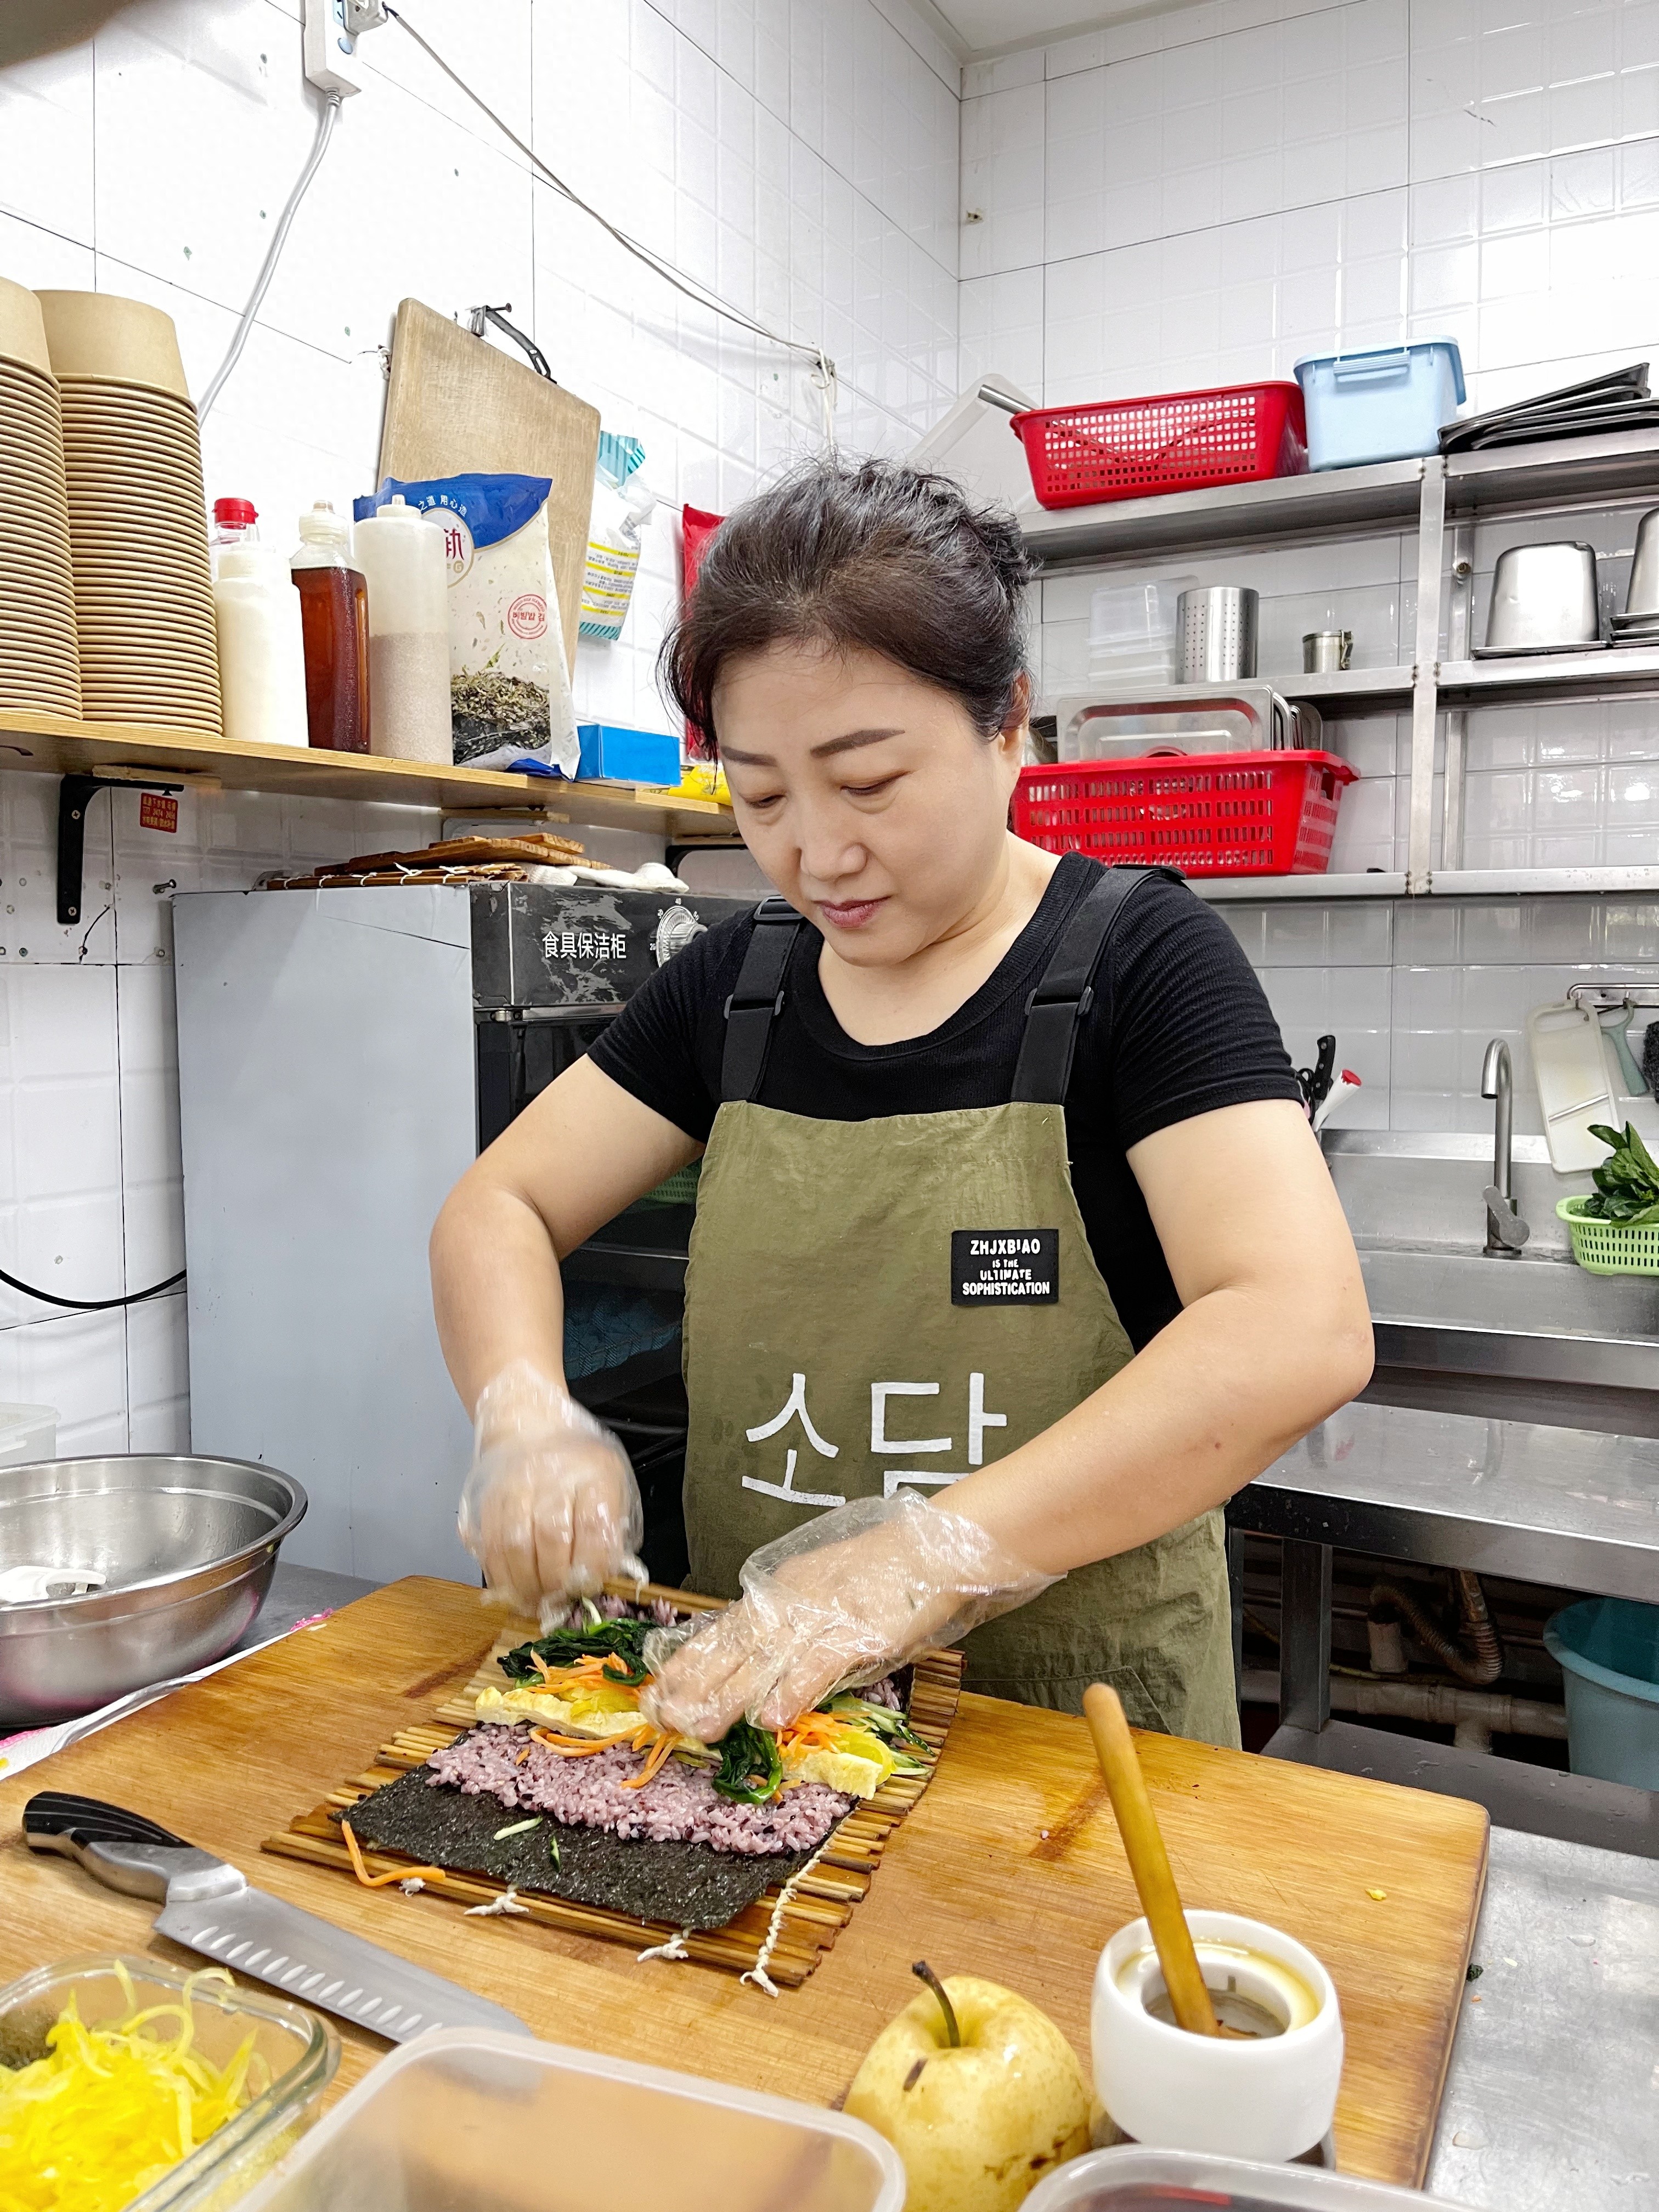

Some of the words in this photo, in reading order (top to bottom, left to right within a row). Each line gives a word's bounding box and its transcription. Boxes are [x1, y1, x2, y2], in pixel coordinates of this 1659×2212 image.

[542, 930, 627, 959] 食具保洁柜
[970, 1238, 1041, 1255] ZHJXBIAO
[992, 1259, 1001, 1268] IS
[1003, 1259, 1019, 1268] THE
[980, 1268, 1032, 1281] ULTIMATE
[962, 1282, 1050, 1295] SOPHISTICATION
